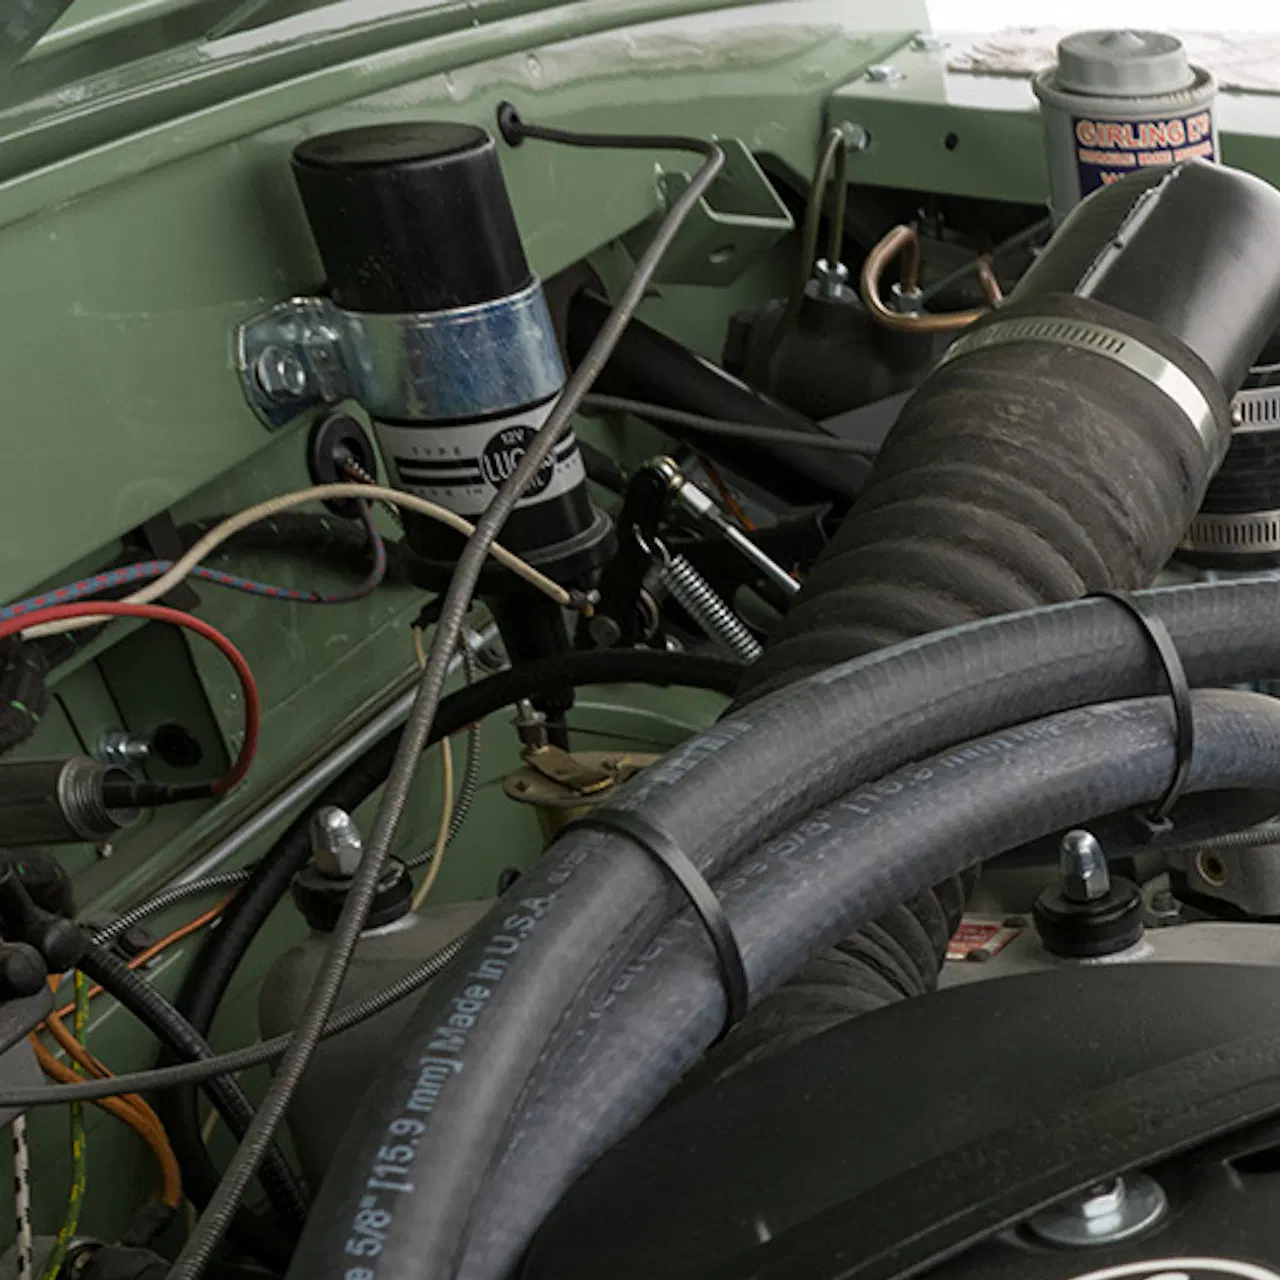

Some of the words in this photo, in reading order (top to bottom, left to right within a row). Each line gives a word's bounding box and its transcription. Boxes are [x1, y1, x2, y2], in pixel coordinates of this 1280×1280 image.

[1078, 119, 1185, 147] GIRLING
[501, 428, 526, 445] 12V
[486, 893, 556, 954] U.S.A.
[467, 957, 509, 981] in
[427, 984, 491, 1052] Made
[406, 1056, 464, 1113] mm]
[367, 1117, 426, 1193] [15.9
[345, 1195, 392, 1256] 5/8"
